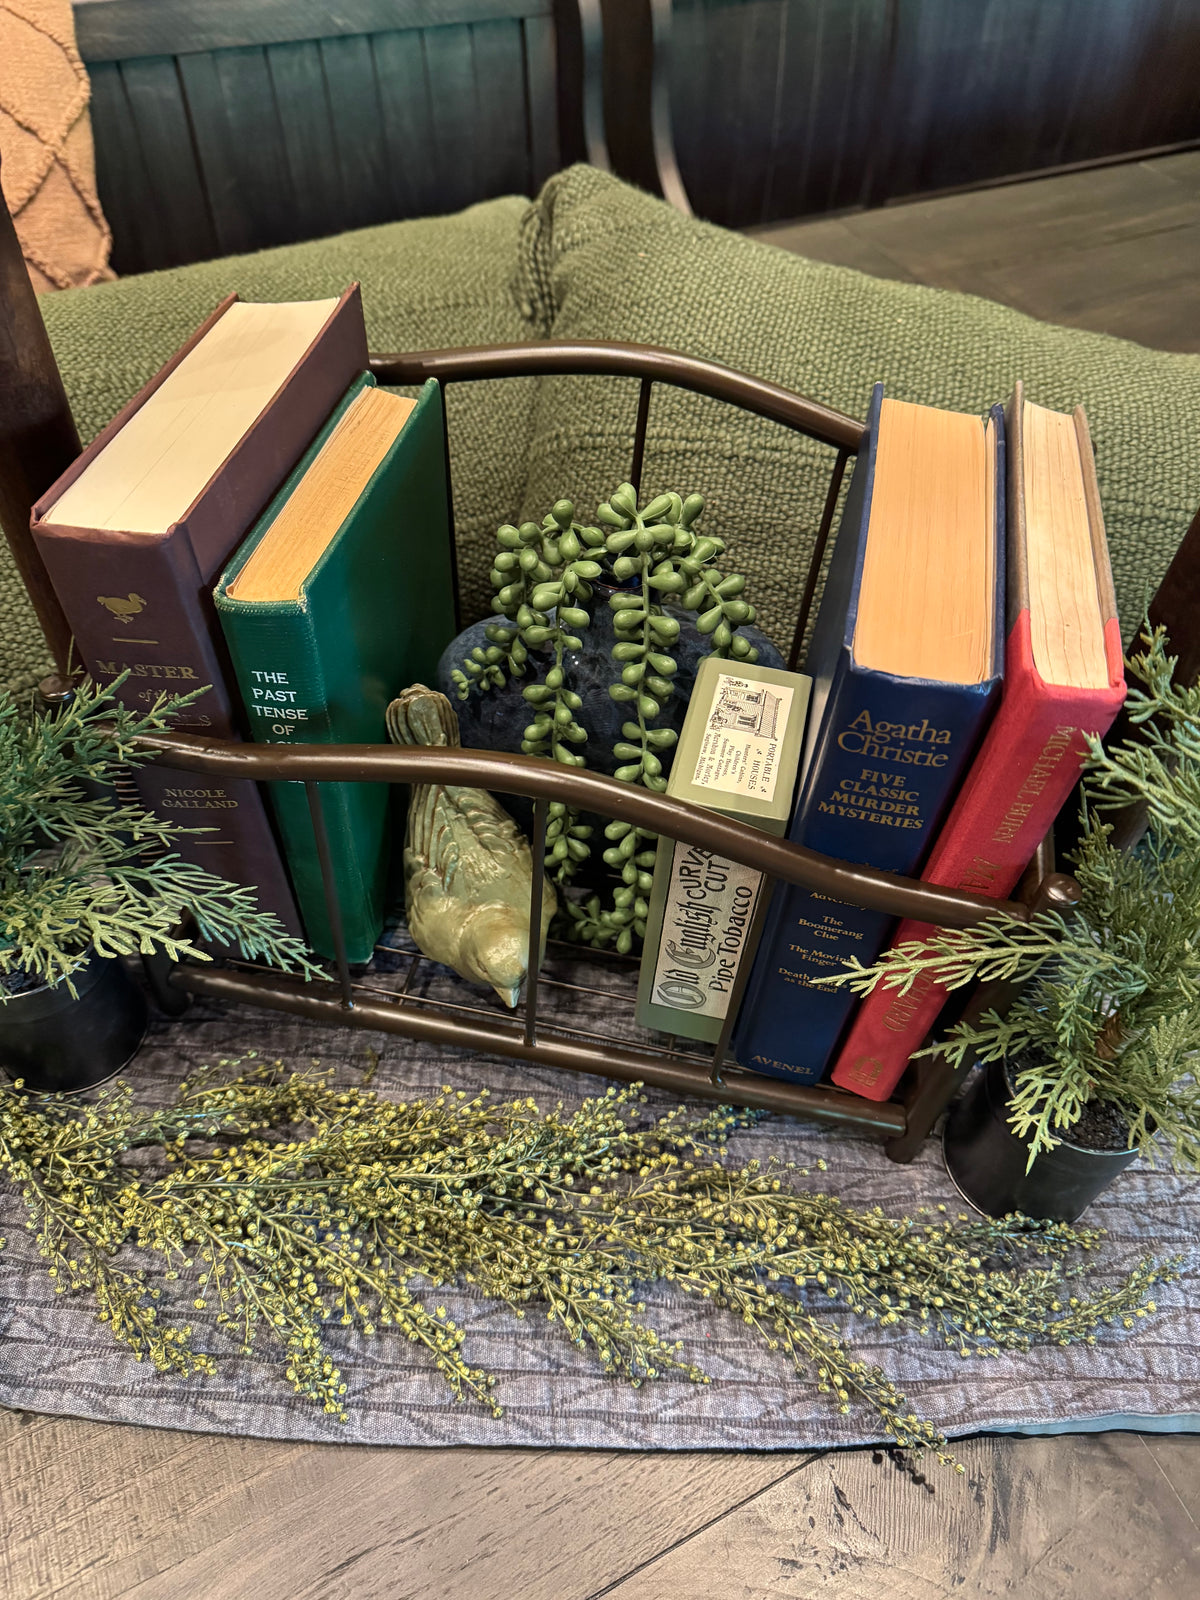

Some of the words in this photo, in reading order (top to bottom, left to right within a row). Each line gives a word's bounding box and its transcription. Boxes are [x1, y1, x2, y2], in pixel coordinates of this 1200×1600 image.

[96, 660, 199, 679] MASTER
[251, 670, 290, 685] THE
[138, 688, 153, 702] of
[251, 687, 297, 703] PAST
[252, 705, 309, 721] TENSE
[272, 724, 296, 736] OF
[848, 709, 952, 745] Agatha
[837, 731, 949, 768] Christie
[762, 742, 777, 783] PORTABLE
[1016, 724, 1078, 799] MICHAEL
[747, 759, 761, 790] HOUSES
[860, 768, 907, 787] FIVE
[164, 788, 227, 798] NICOLE
[839, 779, 920, 802] CLASSIC
[161, 799, 239, 809] GALLAND
[829, 790, 920, 817] MURDER
[817, 800, 924, 830] MYSTERIES
[991, 801, 1034, 844] BURN
[704, 860, 730, 892] CUT
[717, 886, 753, 955] Tobacco
[798, 918, 864, 940] Boomerang
[823, 915, 844, 927] The
[665, 900, 723, 970] English
[813, 929, 839, 941] Clue
[789, 944, 809, 954] The
[801, 954, 838, 967] Finger
[708, 958, 736, 993] Pipe
[778, 967, 810, 981] Death
[657, 968, 707, 1009] Old
[798, 979, 815, 989] the
[817, 984, 839, 994] End
[751, 1055, 814, 1075] AVENEL
